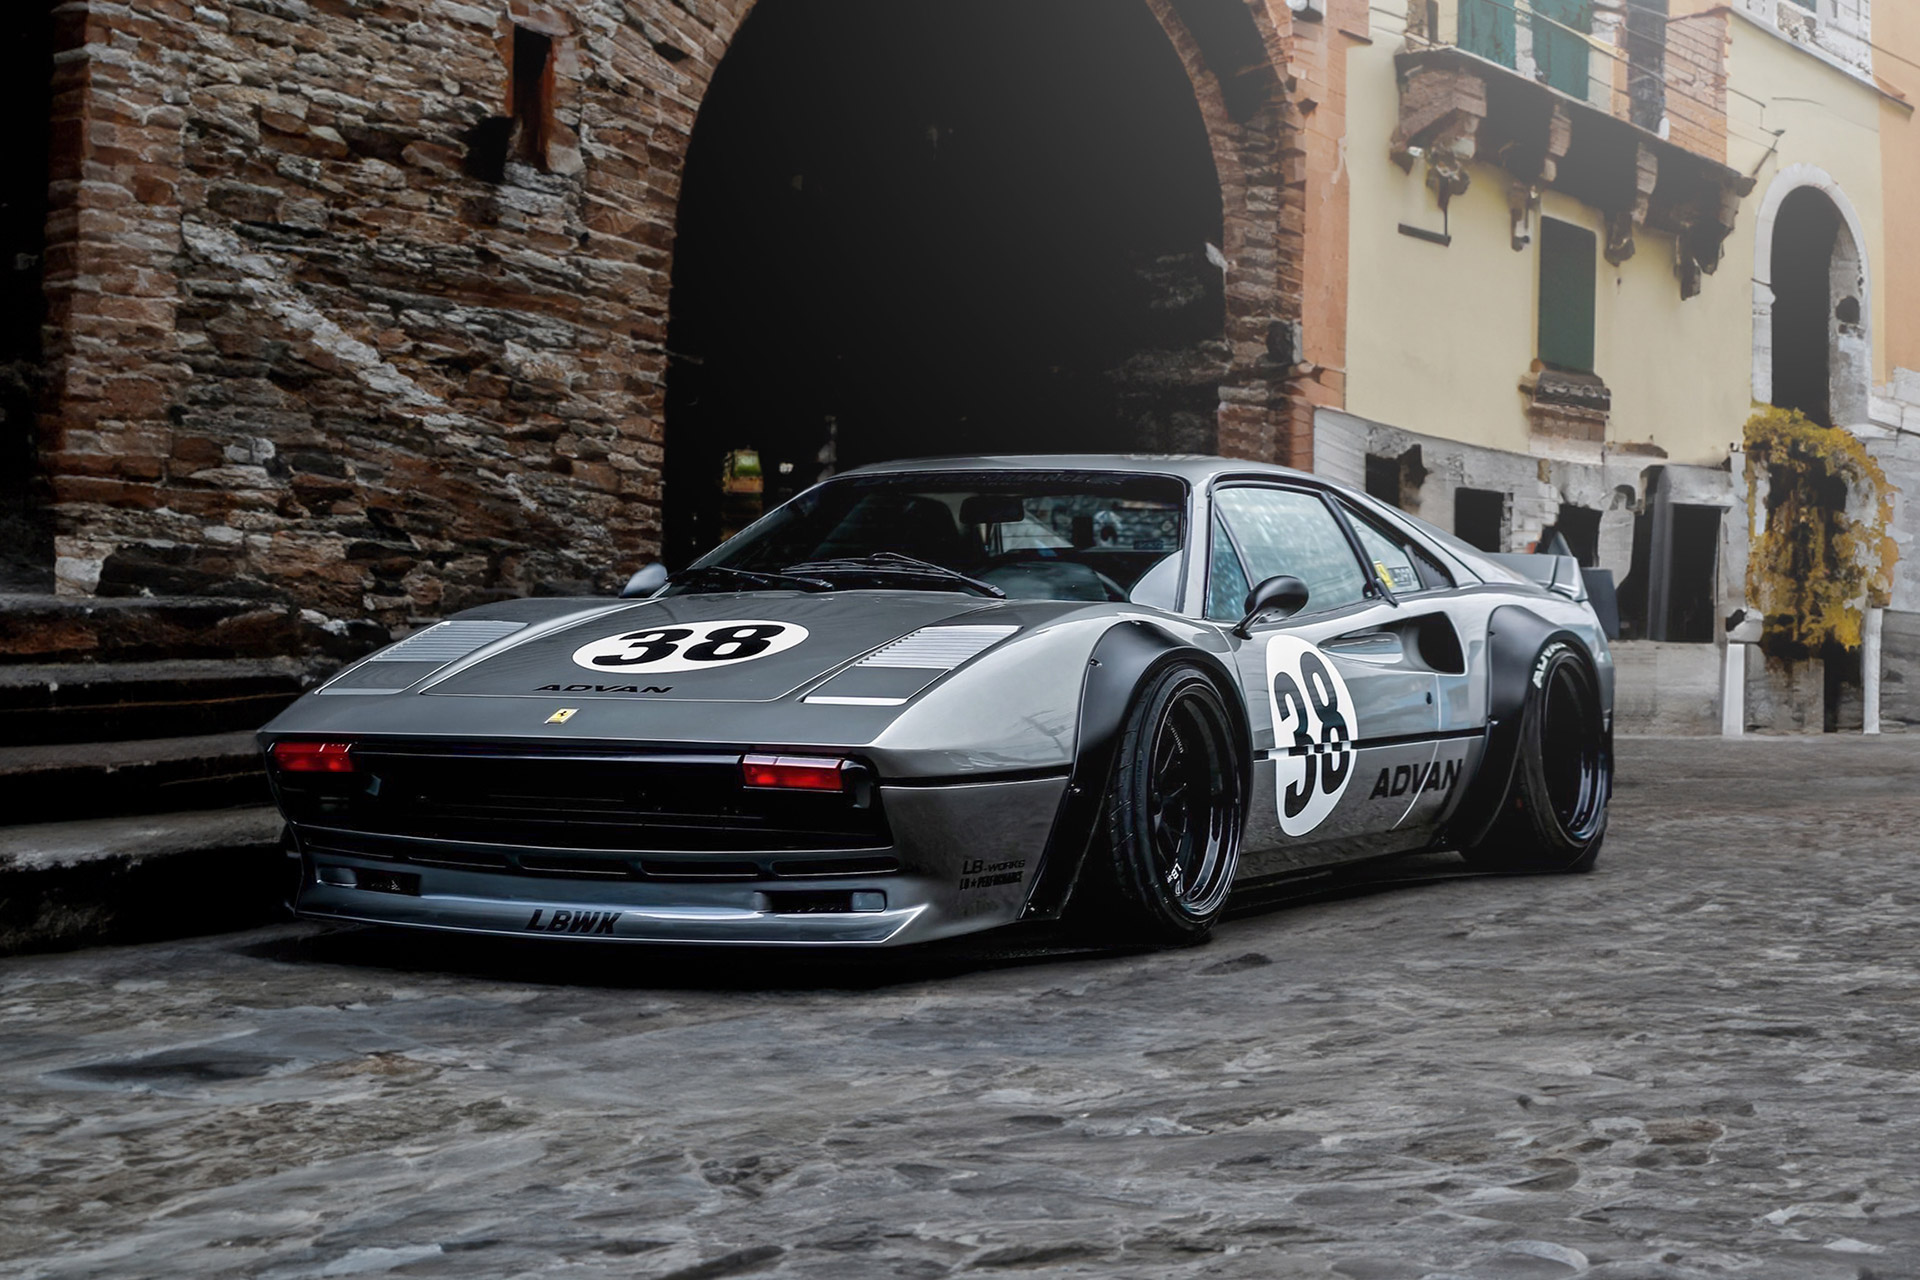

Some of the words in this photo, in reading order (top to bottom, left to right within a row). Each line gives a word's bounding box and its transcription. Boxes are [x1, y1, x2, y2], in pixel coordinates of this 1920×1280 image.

[592, 624, 786, 666] 38
[533, 684, 674, 694] ADVAN
[1274, 651, 1350, 819] 38
[1369, 759, 1463, 800] ADVAN
[524, 909, 622, 935] LBWK
